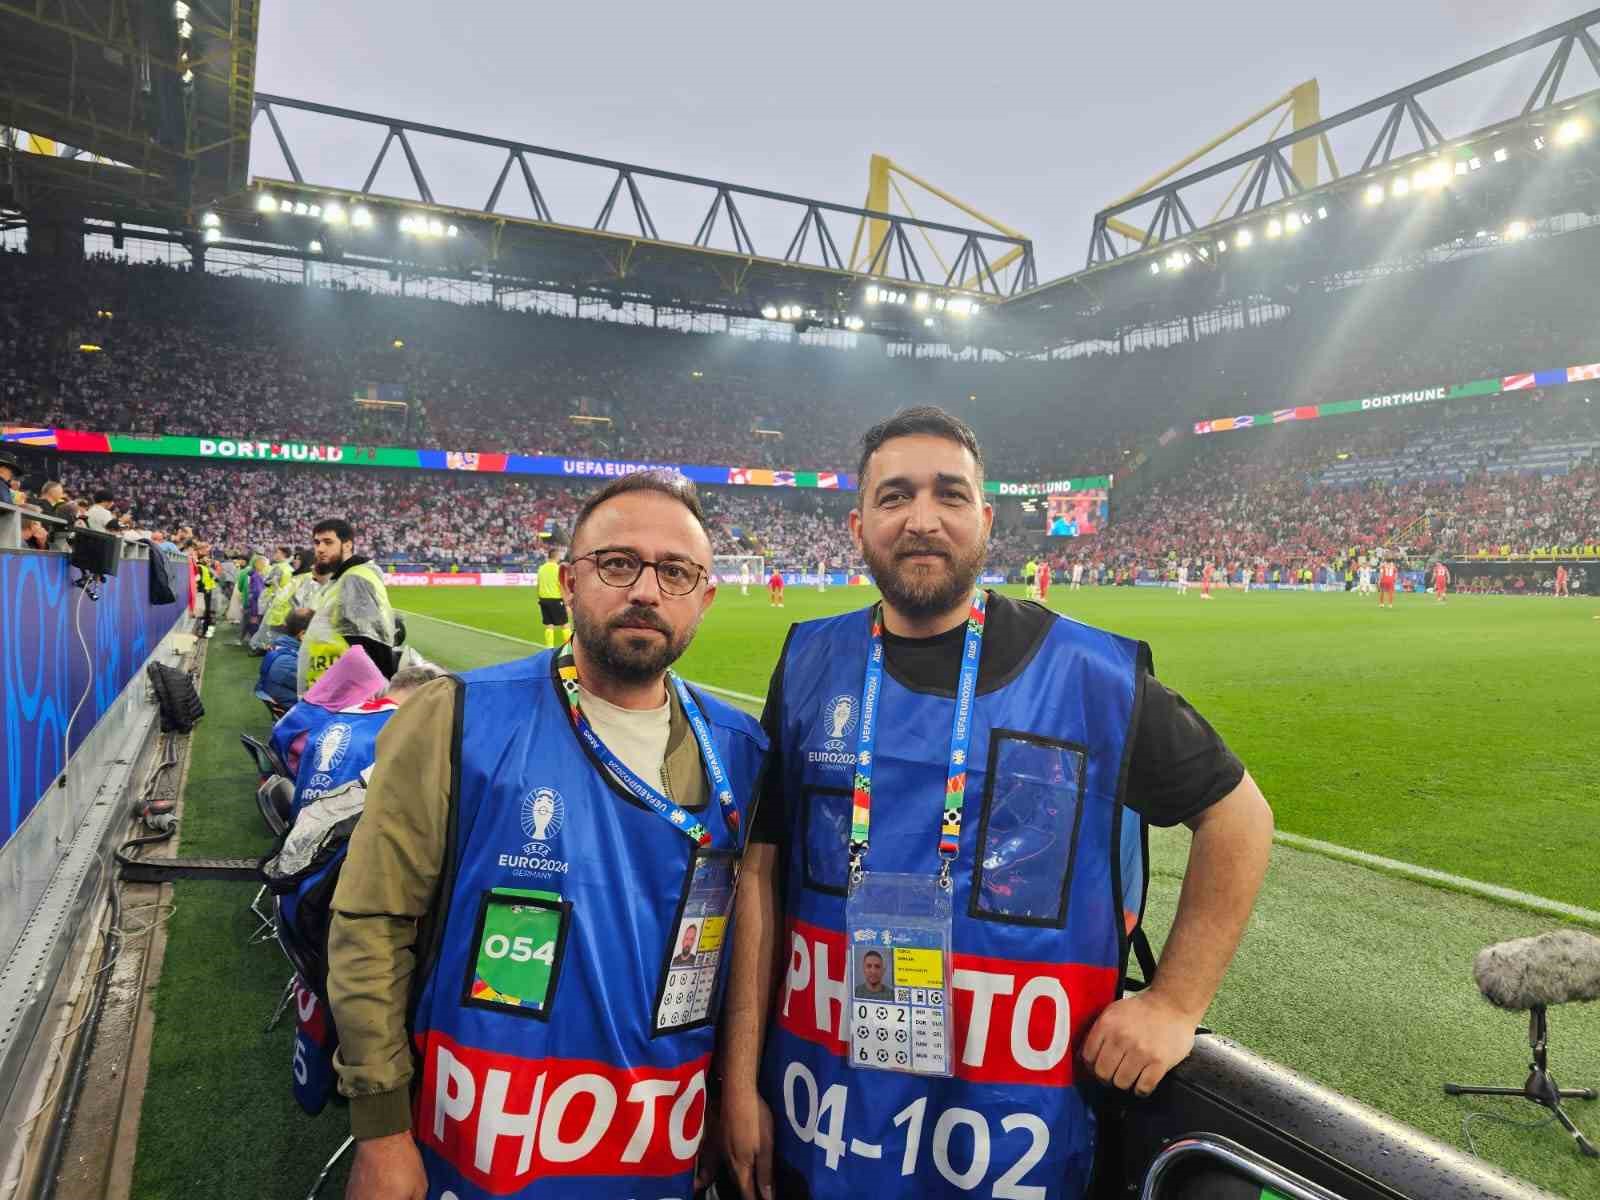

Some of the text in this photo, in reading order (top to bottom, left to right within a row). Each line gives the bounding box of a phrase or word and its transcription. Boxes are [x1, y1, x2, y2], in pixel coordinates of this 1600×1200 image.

[523, 844, 549, 856] UEFA
[498, 854, 568, 874] EURO2024
[669, 973, 676, 987] 0
[782, 930, 1071, 1071] PHTO
[659, 1014, 667, 1026] 6
[858, 1005, 867, 1019] 0
[896, 1008, 905, 1023] 2
[859, 1047, 868, 1061] 6
[433, 1045, 707, 1177] PHOTO
[783, 1062, 1050, 1200] 04-102
